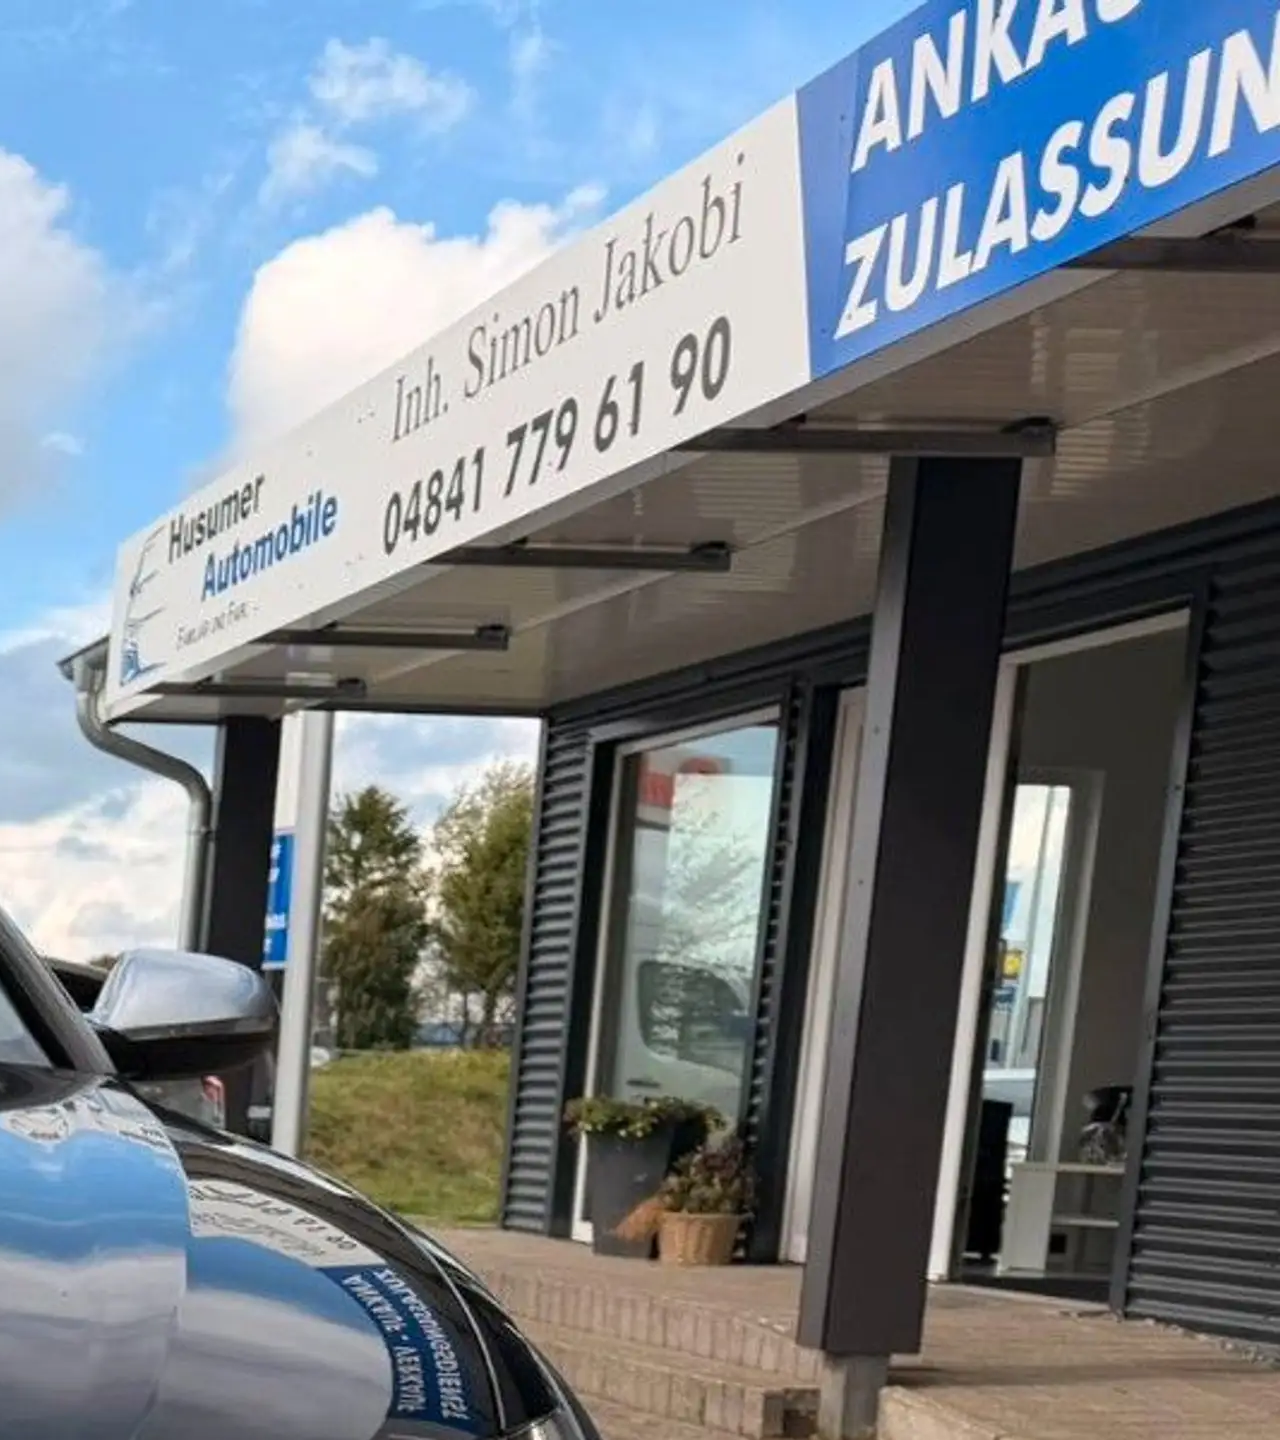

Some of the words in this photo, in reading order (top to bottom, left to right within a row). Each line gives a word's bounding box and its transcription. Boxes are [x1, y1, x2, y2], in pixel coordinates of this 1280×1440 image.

[851, 0, 1140, 174] ANKA
[392, 356, 449, 444] Inh.
[463, 285, 580, 398] Simon
[593, 152, 744, 323] Jakobi
[167, 473, 266, 565] Husumer
[382, 447, 485, 556] 04841
[503, 397, 579, 497] 779
[593, 360, 646, 454] 61
[670, 315, 732, 416] 90
[200, 488, 339, 601] Automobile
